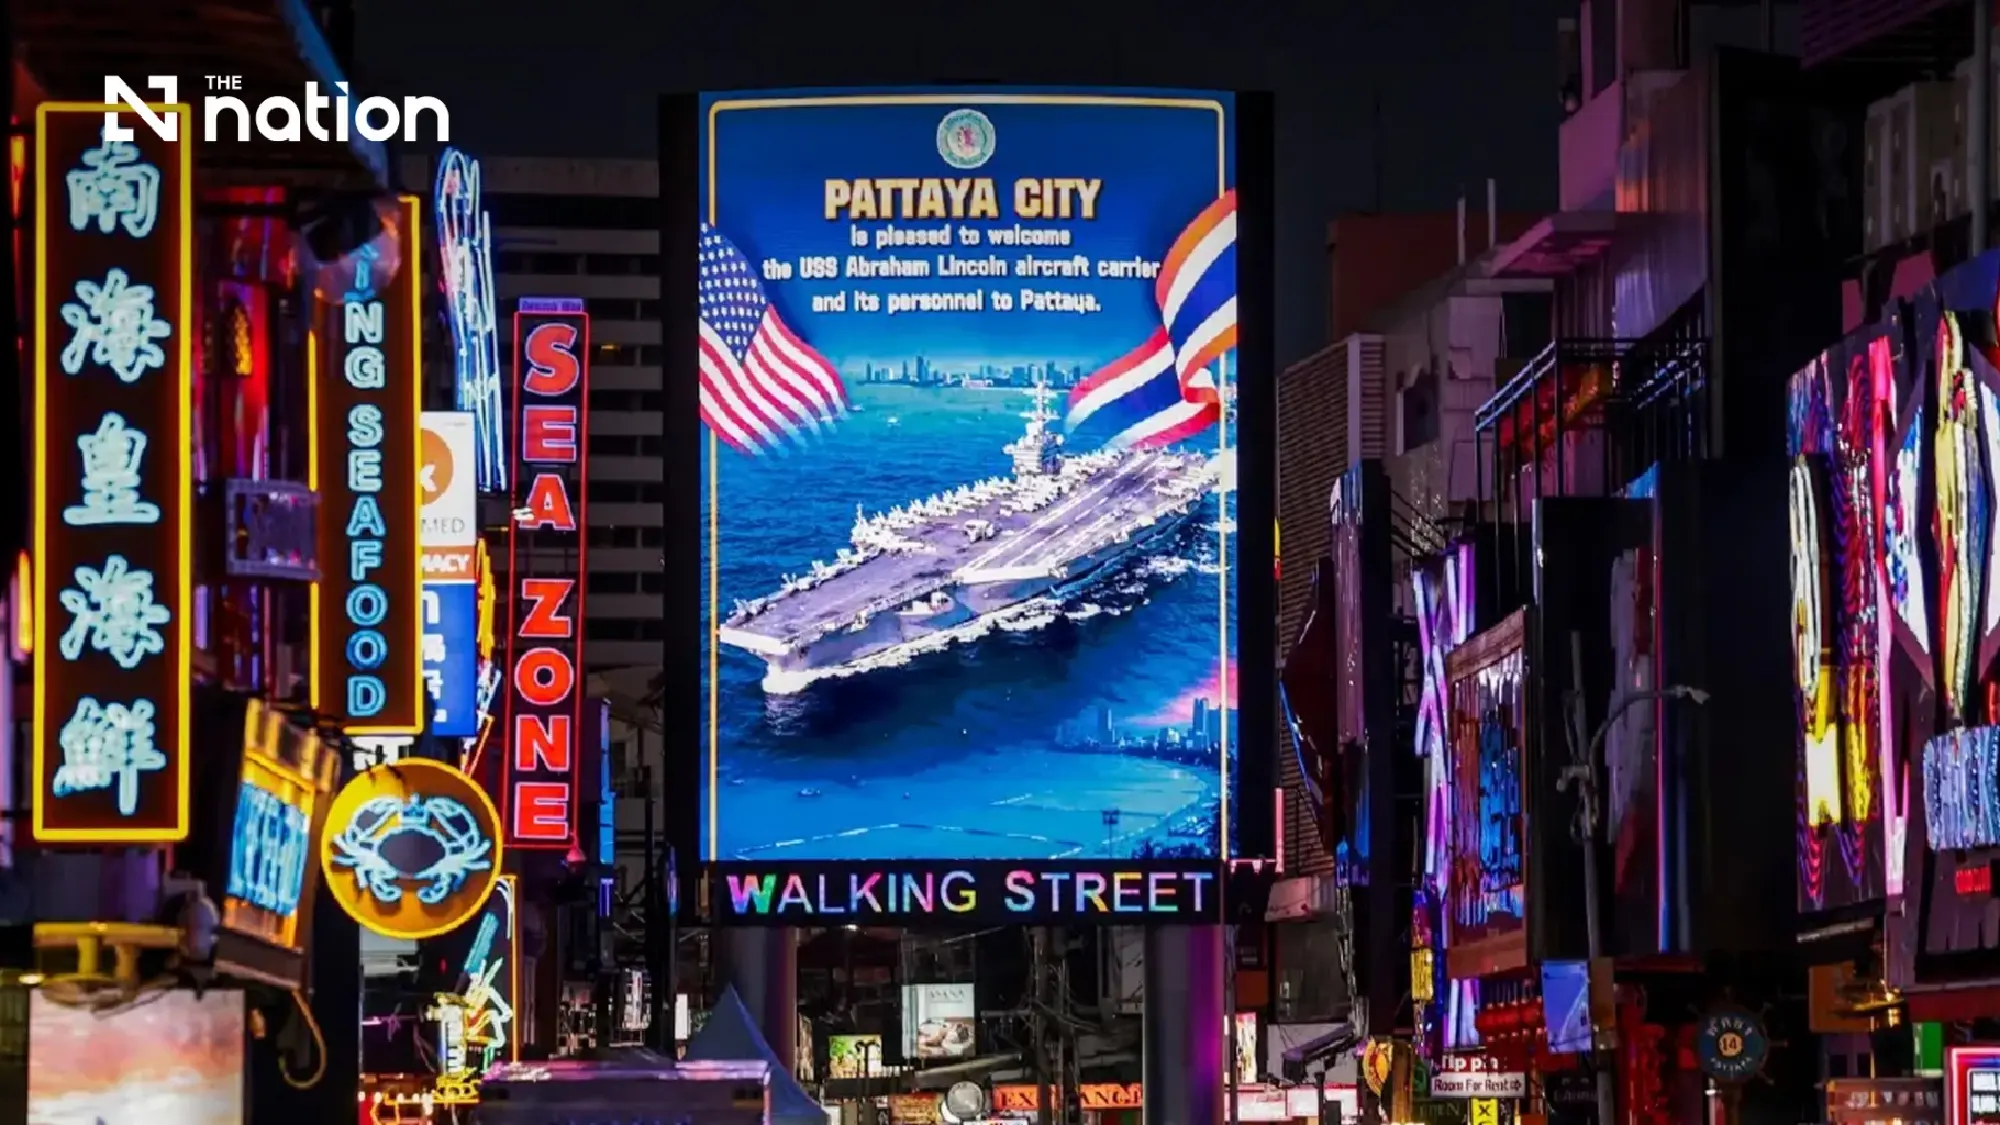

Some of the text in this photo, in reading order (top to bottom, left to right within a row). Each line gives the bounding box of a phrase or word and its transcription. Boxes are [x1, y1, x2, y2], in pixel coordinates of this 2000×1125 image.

[824, 178, 1102, 220] PATTAYA CITY
[875, 223, 951, 250] pleased
[958, 226, 981, 246] to
[987, 223, 1071, 246] welcome
[762, 254, 1161, 280] the USS Abraham Lincoln aircraft carrier
[344, 245, 387, 389] ING
[812, 291, 846, 313] and
[887, 288, 984, 315] personnel
[991, 290, 1013, 312] to
[1020, 288, 1102, 315] Pattaya.
[519, 322, 580, 532] SEA
[346, 404, 388, 717] SEAFOOD
[514, 578, 576, 840] ZONE
[726, 870, 1213, 914] WALKING STREET
[1722, 1037, 1737, 1051] 14
